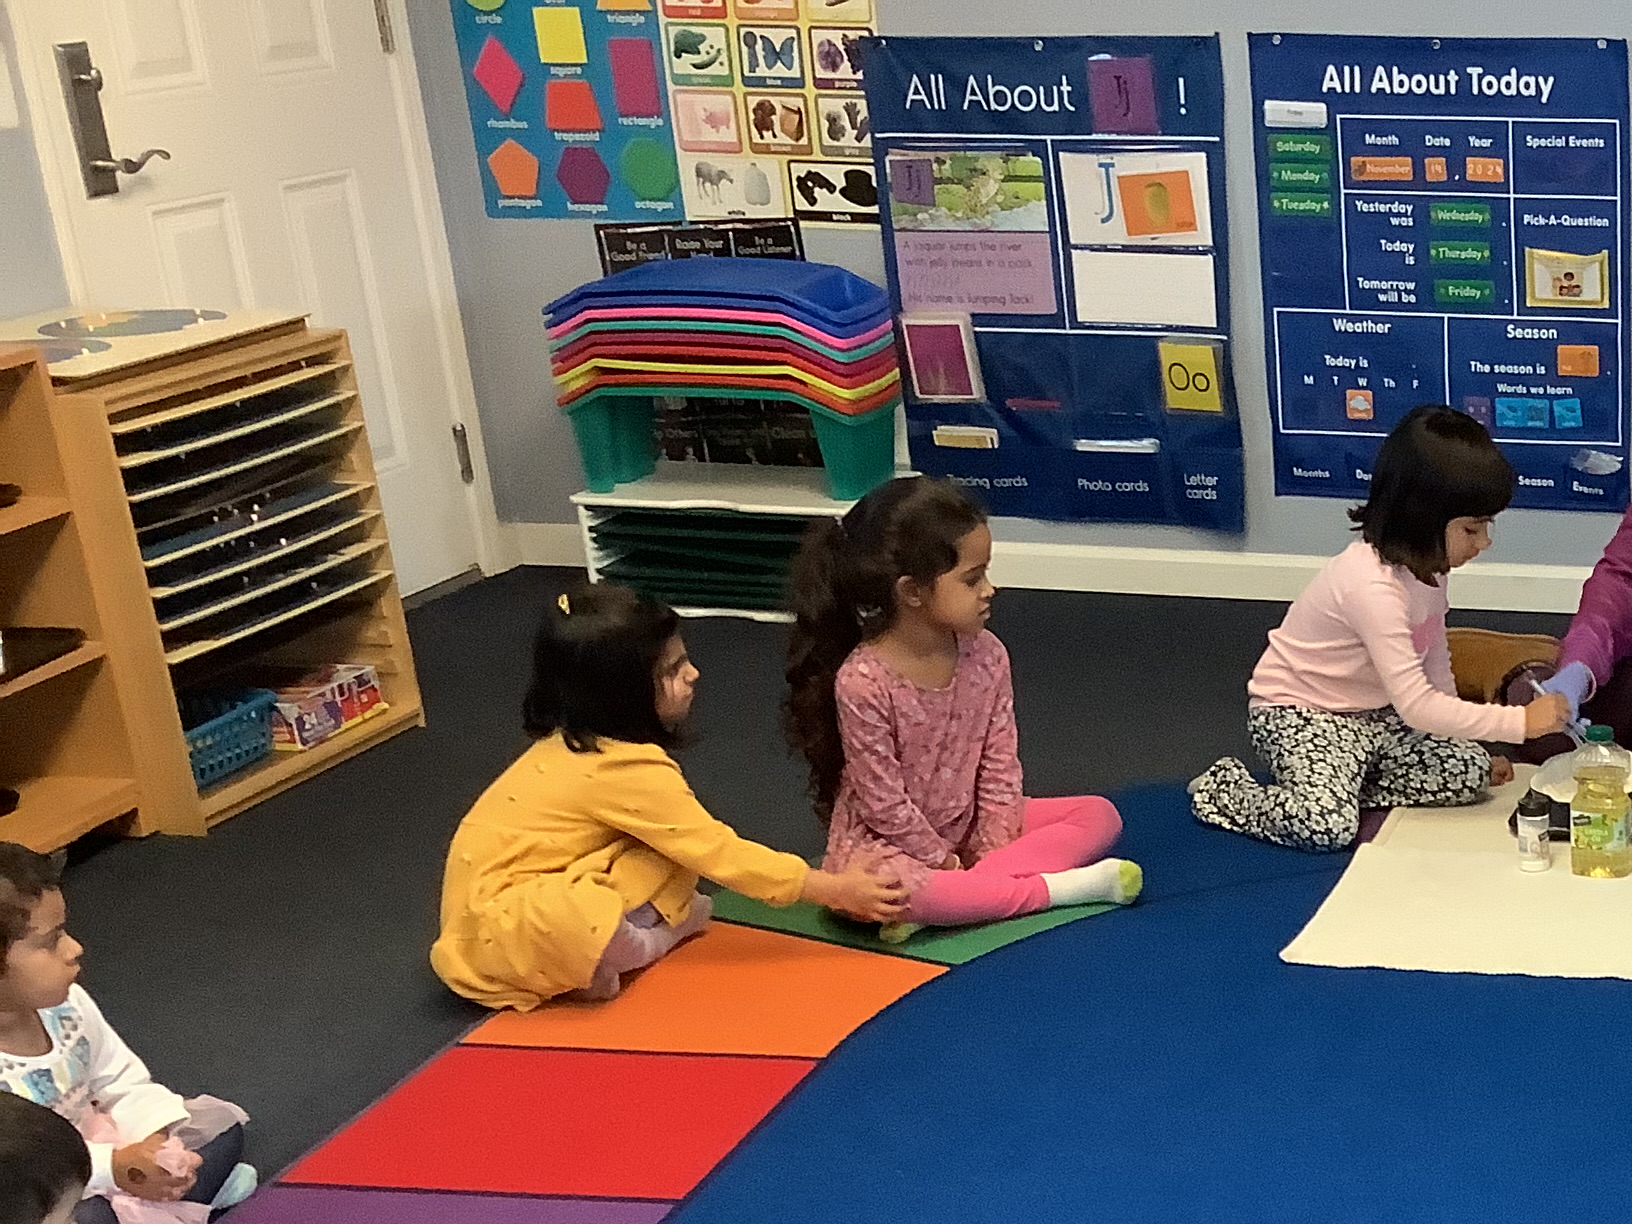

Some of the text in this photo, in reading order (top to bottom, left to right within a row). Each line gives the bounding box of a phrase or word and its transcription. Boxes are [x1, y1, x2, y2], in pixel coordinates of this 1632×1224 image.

[476, 14, 502, 24] circle
[607, 14, 645, 26] triangle
[1322, 64, 1554, 103] All About Today
[906, 74, 947, 110] All
[963, 74, 1076, 112] About
[1177, 77, 1187, 116] !
[487, 118, 528, 129] rhombus
[618, 117, 663, 128] rectangle
[554, 132, 600, 142] trapezoid
[1365, 134, 1493, 147] Month Date Year
[1526, 135, 1605, 149] Special Events
[1276, 141, 1320, 154] Saturday
[1366, 164, 1410, 174] November
[1281, 170, 1320, 182] Monday
[1098, 162, 1115, 224] J
[567, 202, 608, 213] hexagon
[635, 200, 674, 212] octagon
[1281, 199, 1321, 212] Tuesday
[1355, 200, 1484, 224] Yesterday Wednesday
[1389, 216, 1414, 227] was
[1523, 215, 1609, 228] Pick-A-Question
[703, 239, 724, 249] Your
[738, 246, 760, 254] Good
[1380, 239, 1483, 262] Today Thursday
[611, 252, 637, 261] Good
[1404, 253, 1415, 265] is
[1357, 277, 1481, 299] Tomorrow Friday
[1378, 292, 1416, 303] will be
[1333, 318, 1391, 334] Weather
[1507, 325, 1558, 340] Season
[1324, 355, 1368, 369] Today is
[1470, 361, 1546, 375] The season is
[1168, 362, 1211, 392] Oo
[1303, 374, 1419, 389] M T W Th F
[1497, 383, 1573, 395] Words we learn
[1293, 467, 1330, 478] Months
[993, 475, 1028, 488] cards
[1078, 478, 1150, 492] Photo cards
[1183, 473, 1219, 486] Letter
[1518, 475, 1554, 488] Season
[1186, 487, 1217, 500] cards
[1573, 481, 1604, 495] Events
